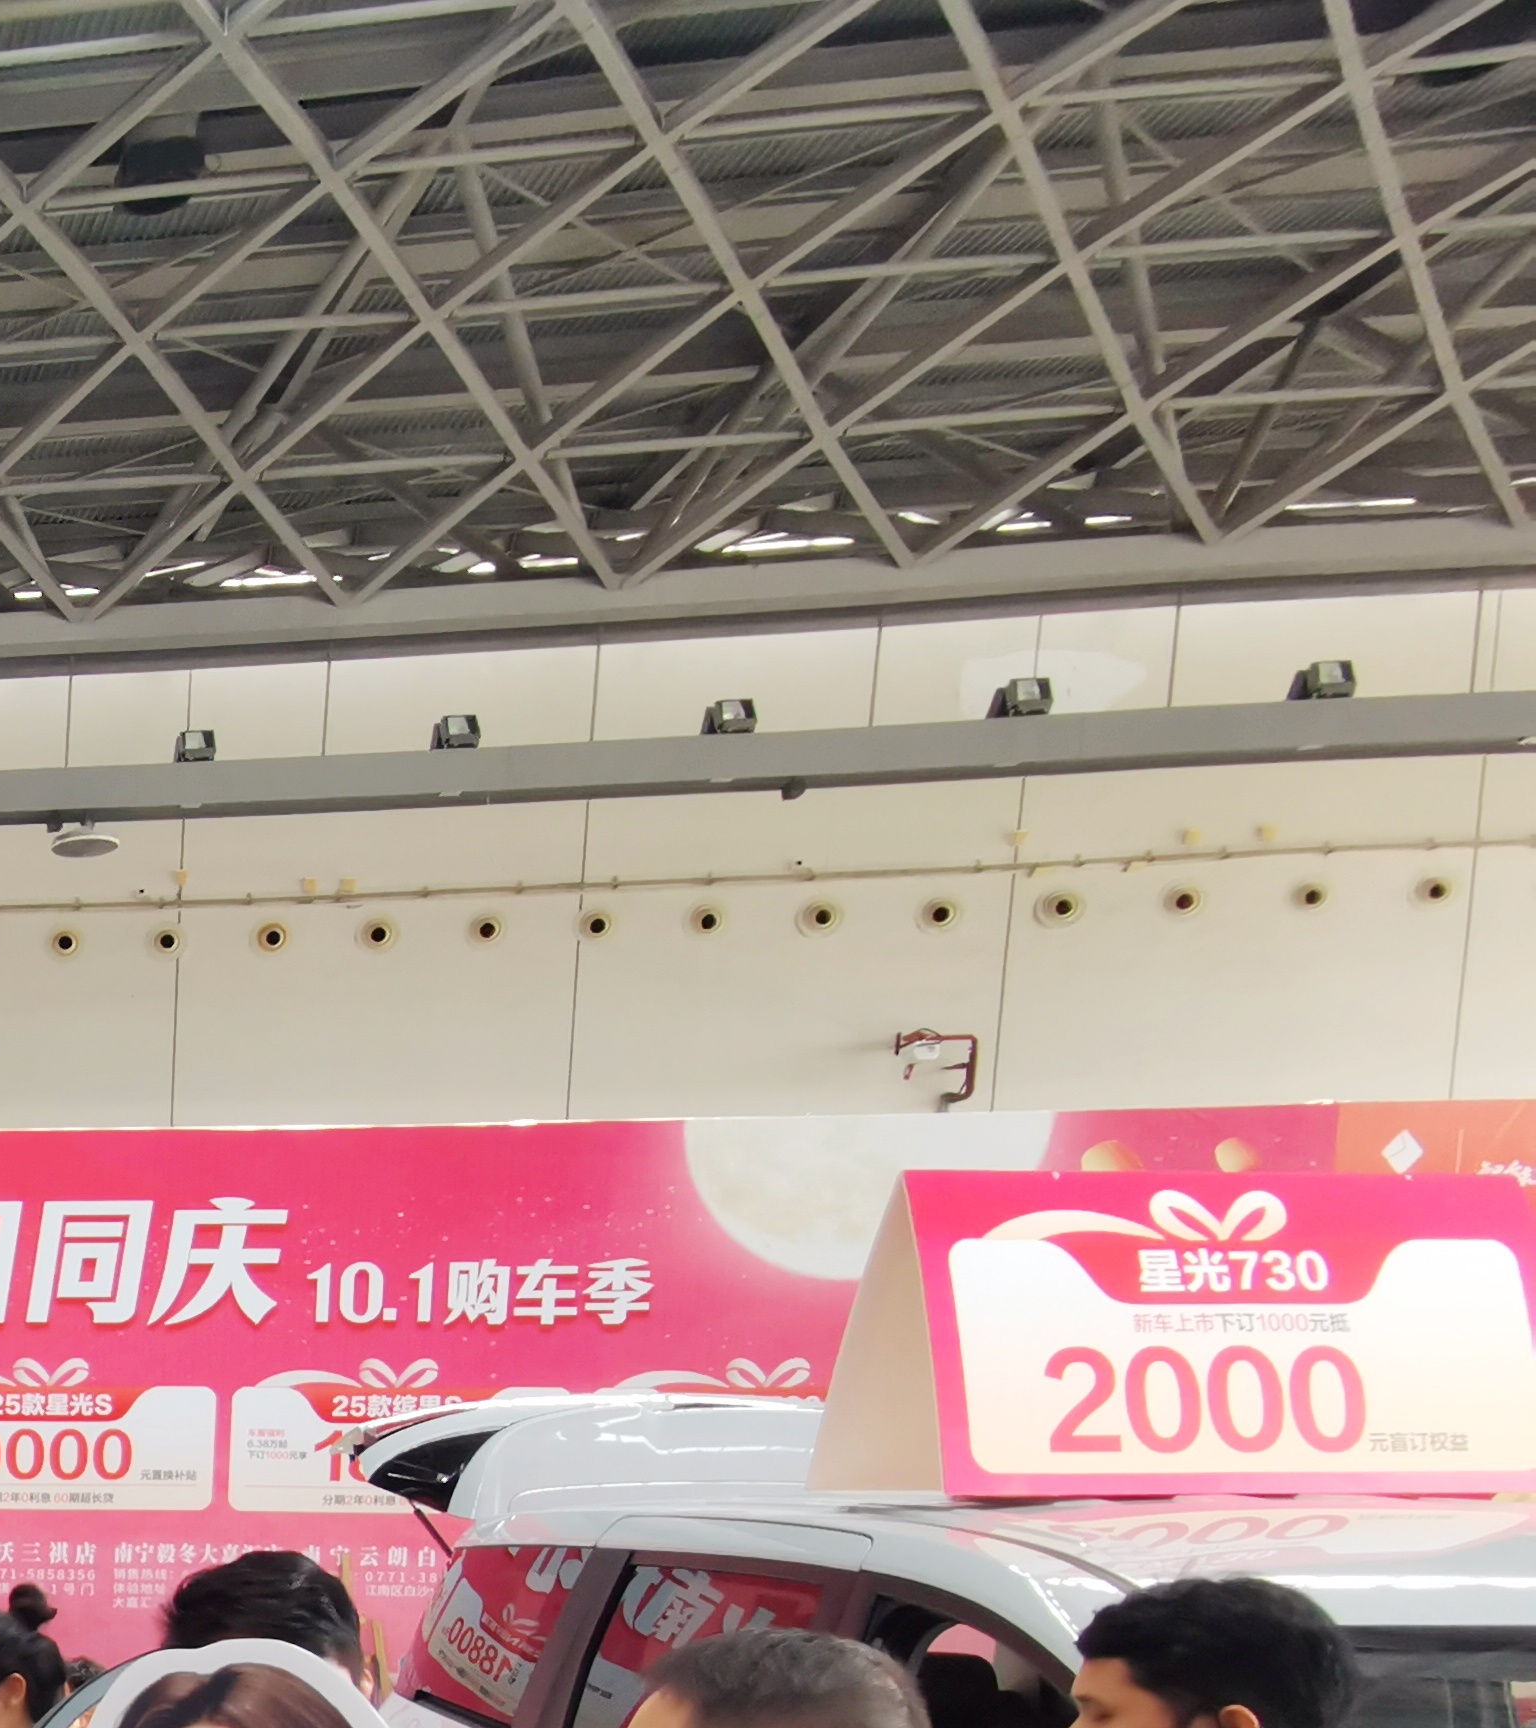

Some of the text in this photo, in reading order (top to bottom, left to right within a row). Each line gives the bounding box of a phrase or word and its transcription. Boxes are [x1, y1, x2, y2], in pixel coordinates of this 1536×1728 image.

[306, 1257, 655, 1326] 10.1购车季
[1136, 1246, 1330, 1295] 星光730
[1043, 1344, 1368, 1454] 2000
